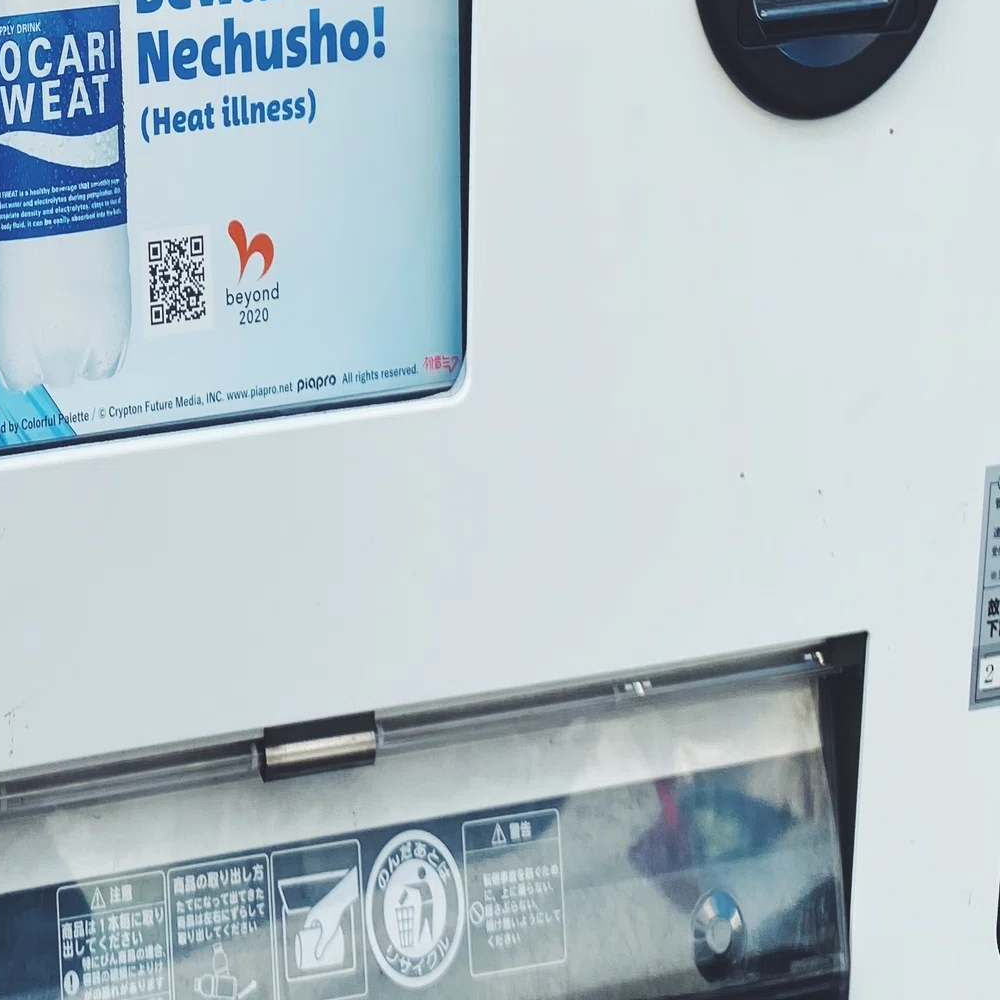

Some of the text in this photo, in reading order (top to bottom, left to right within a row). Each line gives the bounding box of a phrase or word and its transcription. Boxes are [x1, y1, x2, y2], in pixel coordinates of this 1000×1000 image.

[16, 21, 42, 35] DRINK
[137, 6, 386, 85] Nechusho!
[141, 87, 316, 143] (Heat illness)
[23, 198, 34, 208] and
[34, 195, 67, 206] electrolytes
[68, 193, 86, 203] during
[30, 186, 51, 196] healthy
[52, 183, 77, 193] beverage
[79, 181, 90, 190] that
[33, 219, 43, 227] can
[44, 217, 52, 227] be
[71, 213, 96, 222] absorbed
[43, 207, 54, 216] and
[225, 281, 280, 309] beyond
[239, 307, 270, 326] 2020
[8, 418, 19, 434] by
[21, 414, 56, 431] Colorful
[58, 410, 90, 426] Palette
[108, 404, 143, 419] Crypton
[144, 399, 174, 413] Future
[175, 393, 205, 409] Media,
[226, 381, 293, 401] www.piapro.net
[296, 373, 337, 393] piapro
[342, 372, 354, 384] All
[354, 369, 379, 385] rights
[380, 363, 419, 379] reserved.
[173, 863, 265, 896] 商品の取り出し方
[176, 886, 265, 913] たてになって出てきた
[63, 930, 143, 958] 出してください
[177, 920, 258, 946] 取り出してください
[385, 936, 450, 976] リサイクル
